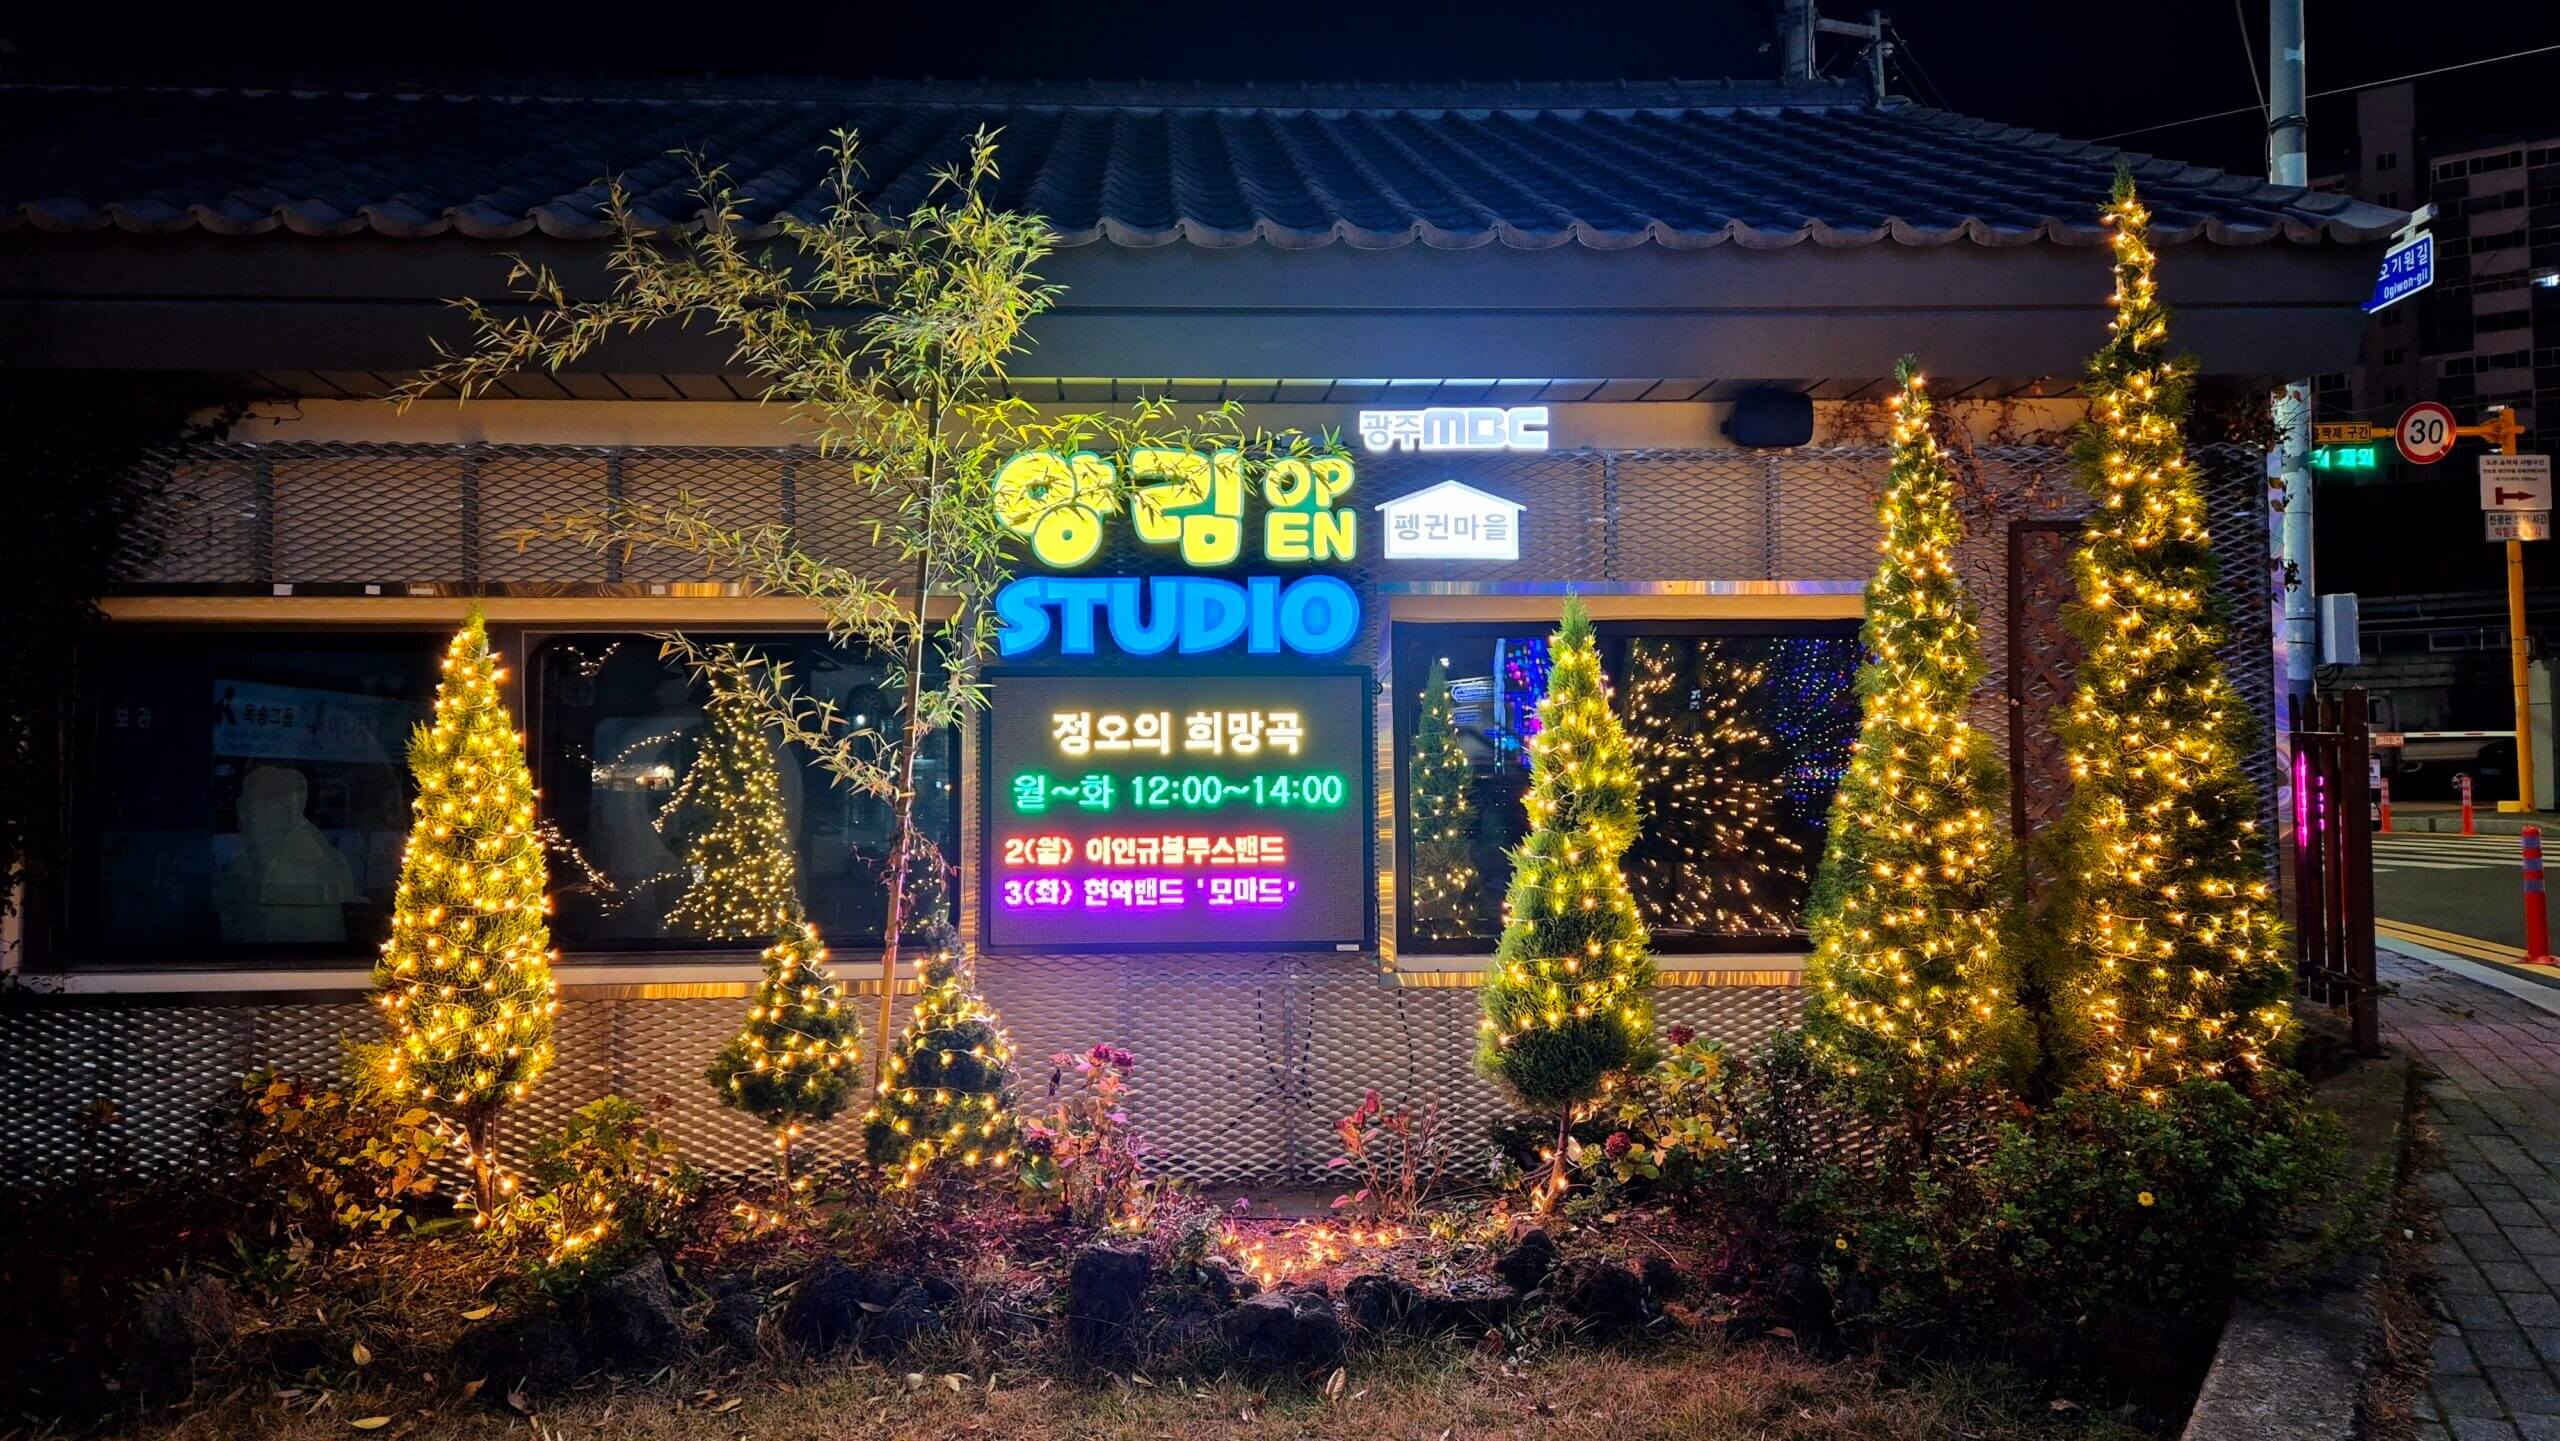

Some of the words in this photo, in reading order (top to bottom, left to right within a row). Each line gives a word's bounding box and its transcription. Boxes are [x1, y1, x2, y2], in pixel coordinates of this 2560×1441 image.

[2378, 242, 2429, 281] 오기원길
[2384, 267, 2428, 299] Ogiwon-gil
[2347, 426, 2369, 440] 구간
[2410, 419, 2444, 444] 30
[1264, 457, 1357, 509] OP
[993, 448, 1243, 568] 양림
[1264, 508, 1357, 562] EN
[1394, 513, 1509, 541] 펭귄마을
[996, 574, 1360, 656] STUDIO
[1052, 711, 1172, 754] 정오의
[1185, 711, 1305, 755] 희망곡
[1013, 774, 1115, 810] 월~화
[1131, 774, 1343, 806] 12:00~14:00
[1004, 836, 1073, 866] 2(월)
[1085, 835, 1287, 866] 이인규블루스밴드
[1004, 877, 1073, 907] 3(화)
